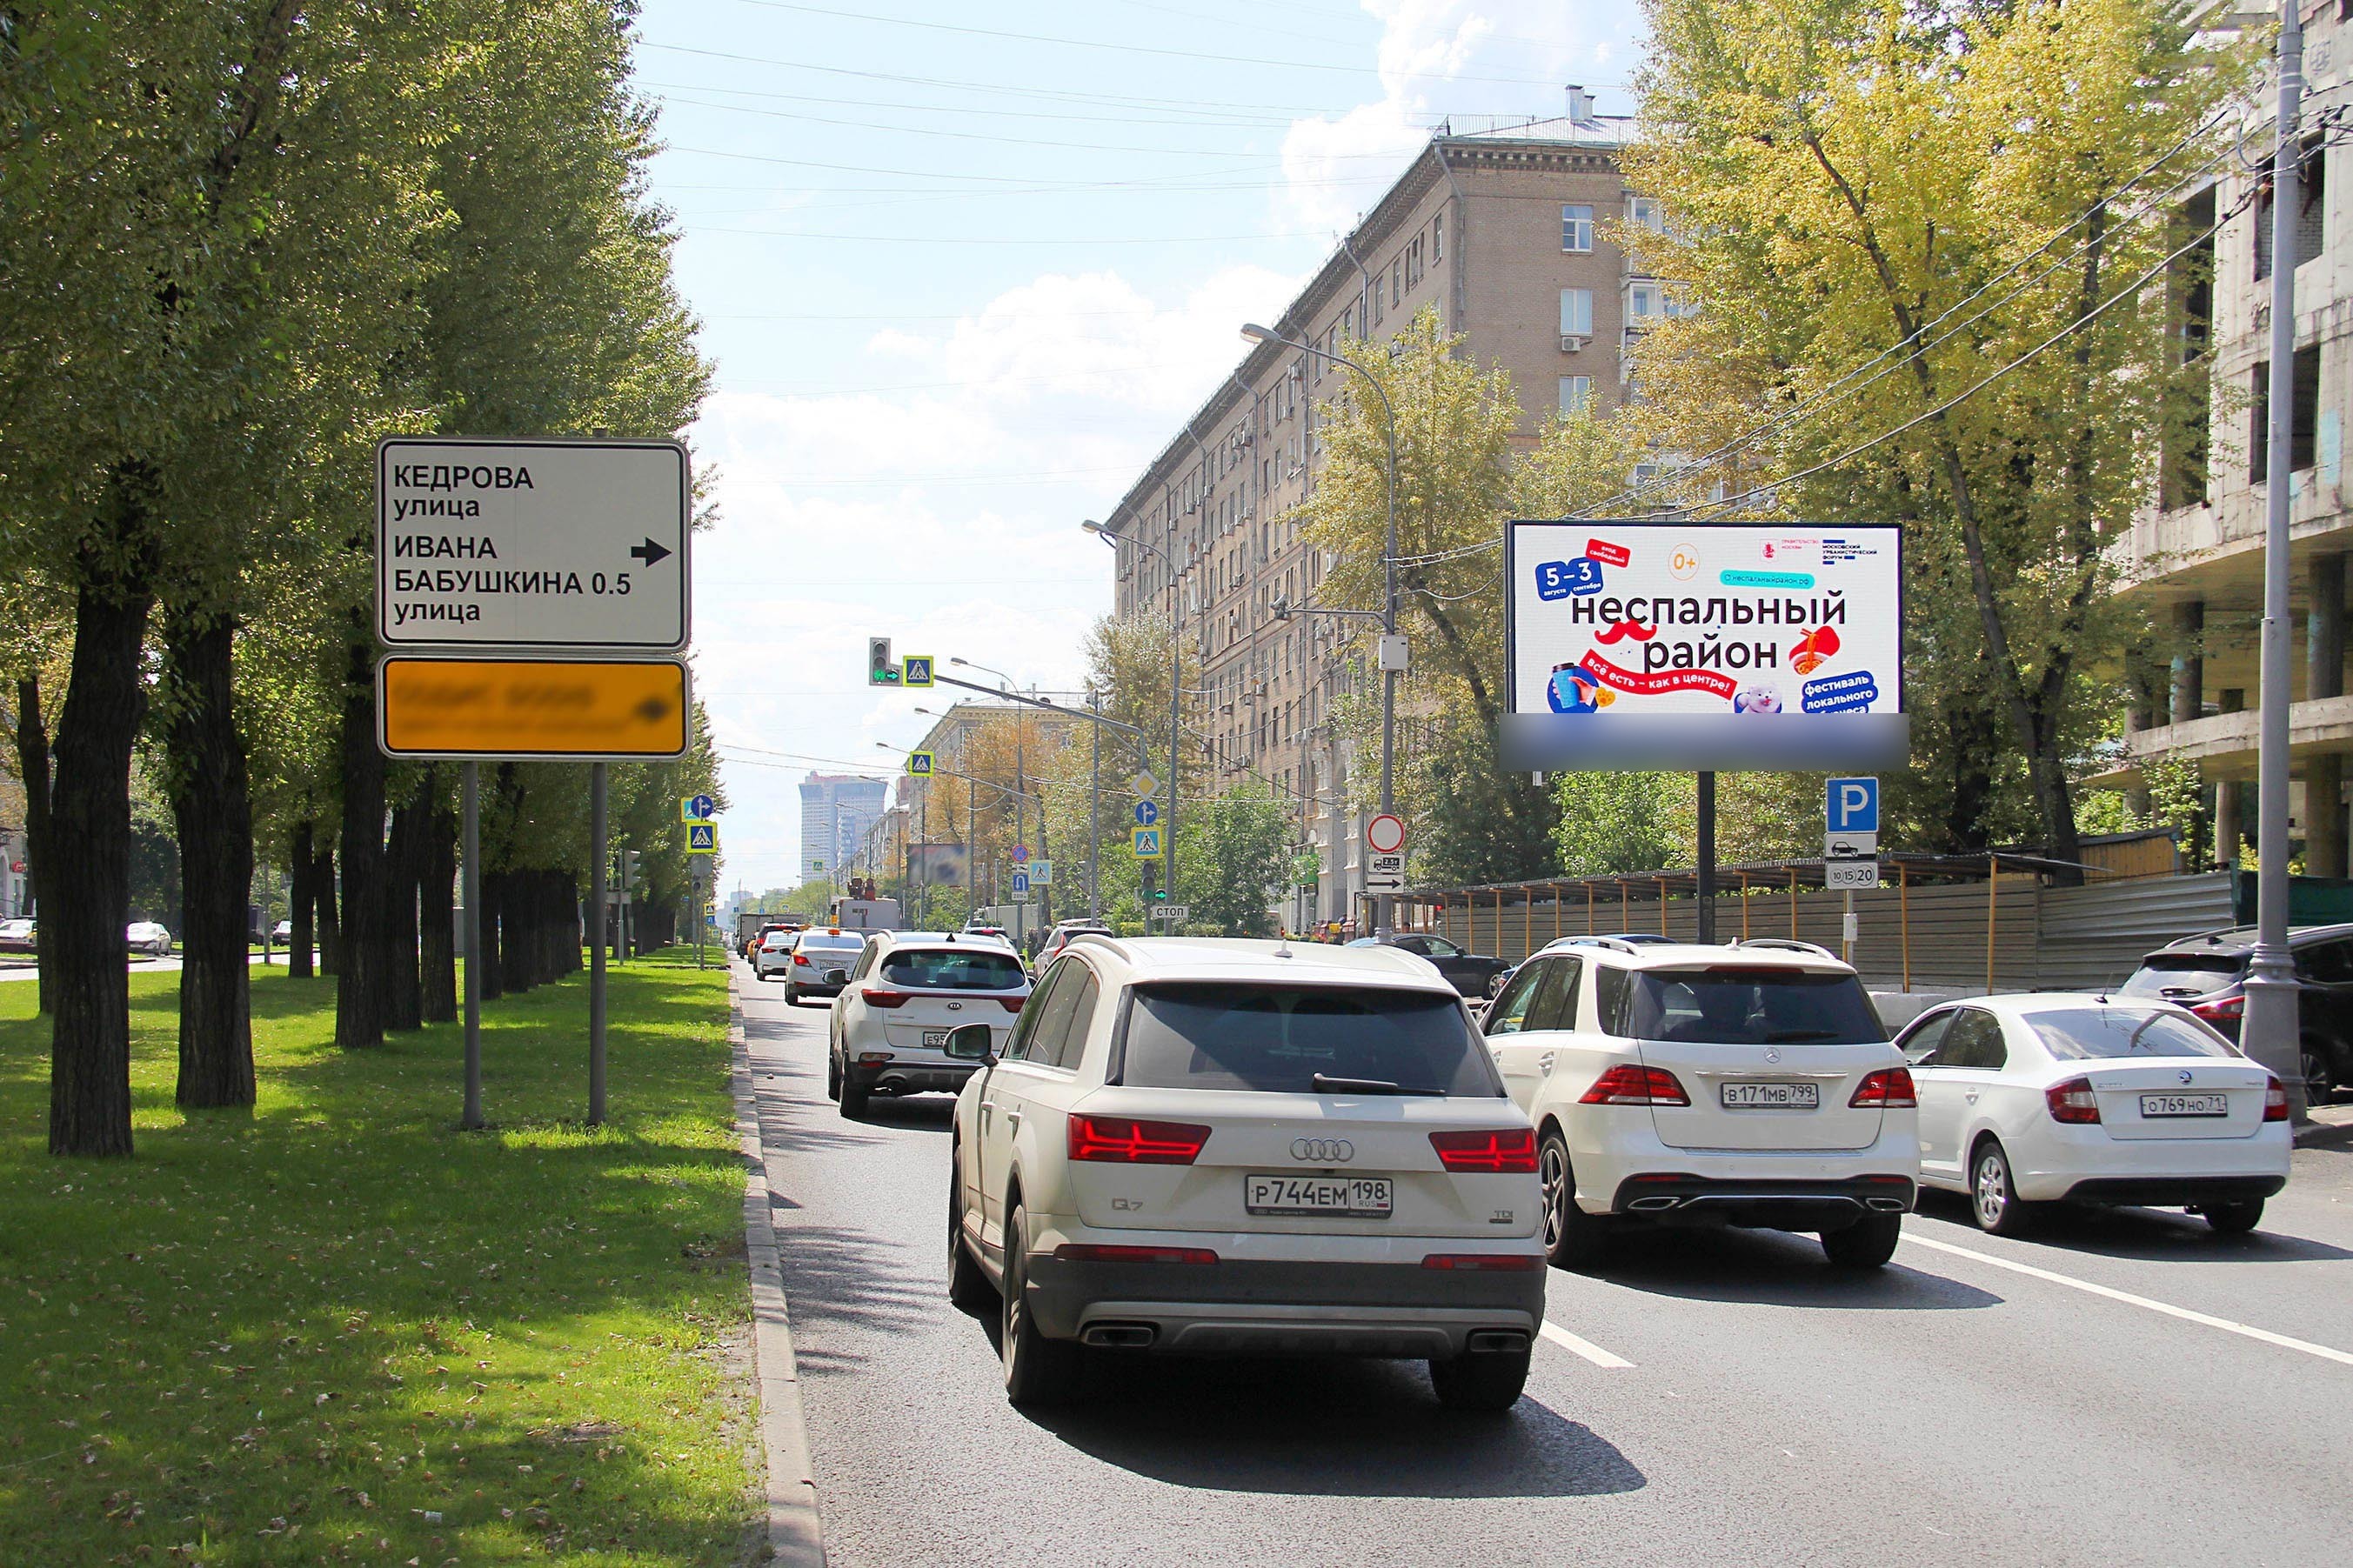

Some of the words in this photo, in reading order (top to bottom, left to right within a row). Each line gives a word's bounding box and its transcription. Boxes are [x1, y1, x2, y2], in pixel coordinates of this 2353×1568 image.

[394, 465, 534, 491] КЕДРОВА
[394, 499, 480, 520] улица
[395, 536, 498, 559] ИВАНА
[1589, 550, 1625, 563] свободный
[1601, 546, 1617, 555] вход
[1674, 553, 1695, 570] 0+
[395, 570, 584, 594] БАБУШКИНА
[592, 573, 632, 595] 0.5
[1544, 588, 1567, 597] августа
[1573, 583, 1601, 591] сентября
[394, 603, 481, 625] улица
[1572, 590, 1846, 624] неспальный
[1644, 633, 1777, 674] район
[1588, 658, 1608, 676] всё
[1608, 673, 1635, 687] есть
[1648, 679, 1670, 689] как
[1683, 674, 1731, 692] центре!
[1804, 676, 1869, 697] фестиваль
[1807, 690, 1873, 710] локального
[1841, 784, 1868, 827] P
[1845, 871, 1854, 880] 15
[1857, 870, 1873, 881] 20
[1352, 1181, 1386, 1199] 198
[1112, 1198, 1143, 1211] Q7
